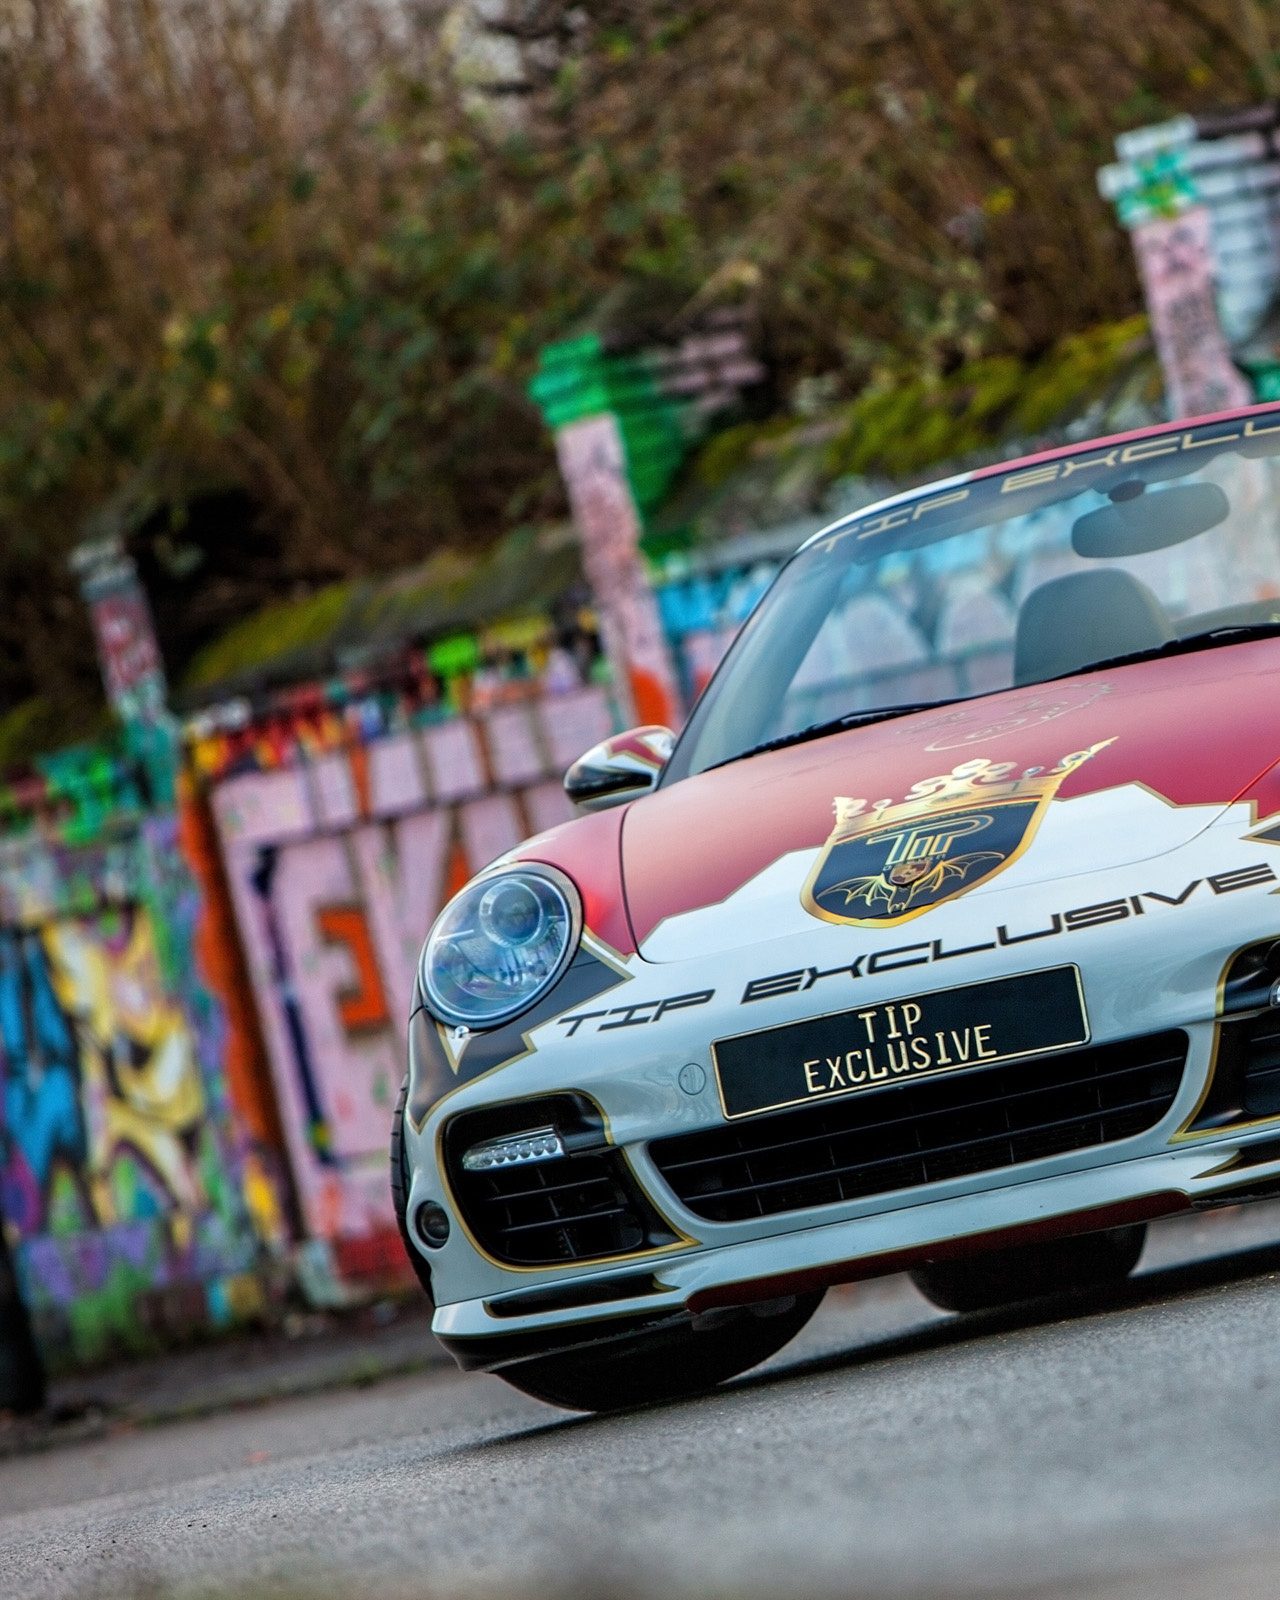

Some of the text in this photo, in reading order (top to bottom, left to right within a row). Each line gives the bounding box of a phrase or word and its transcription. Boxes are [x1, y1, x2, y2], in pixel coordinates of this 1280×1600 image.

[811, 490, 970, 554] TIP
[556, 862, 1278, 1038] TIP EXCLUSIVE
[857, 1002, 923, 1045] TIP
[803, 1024, 998, 1094] EXCLUSIVE
